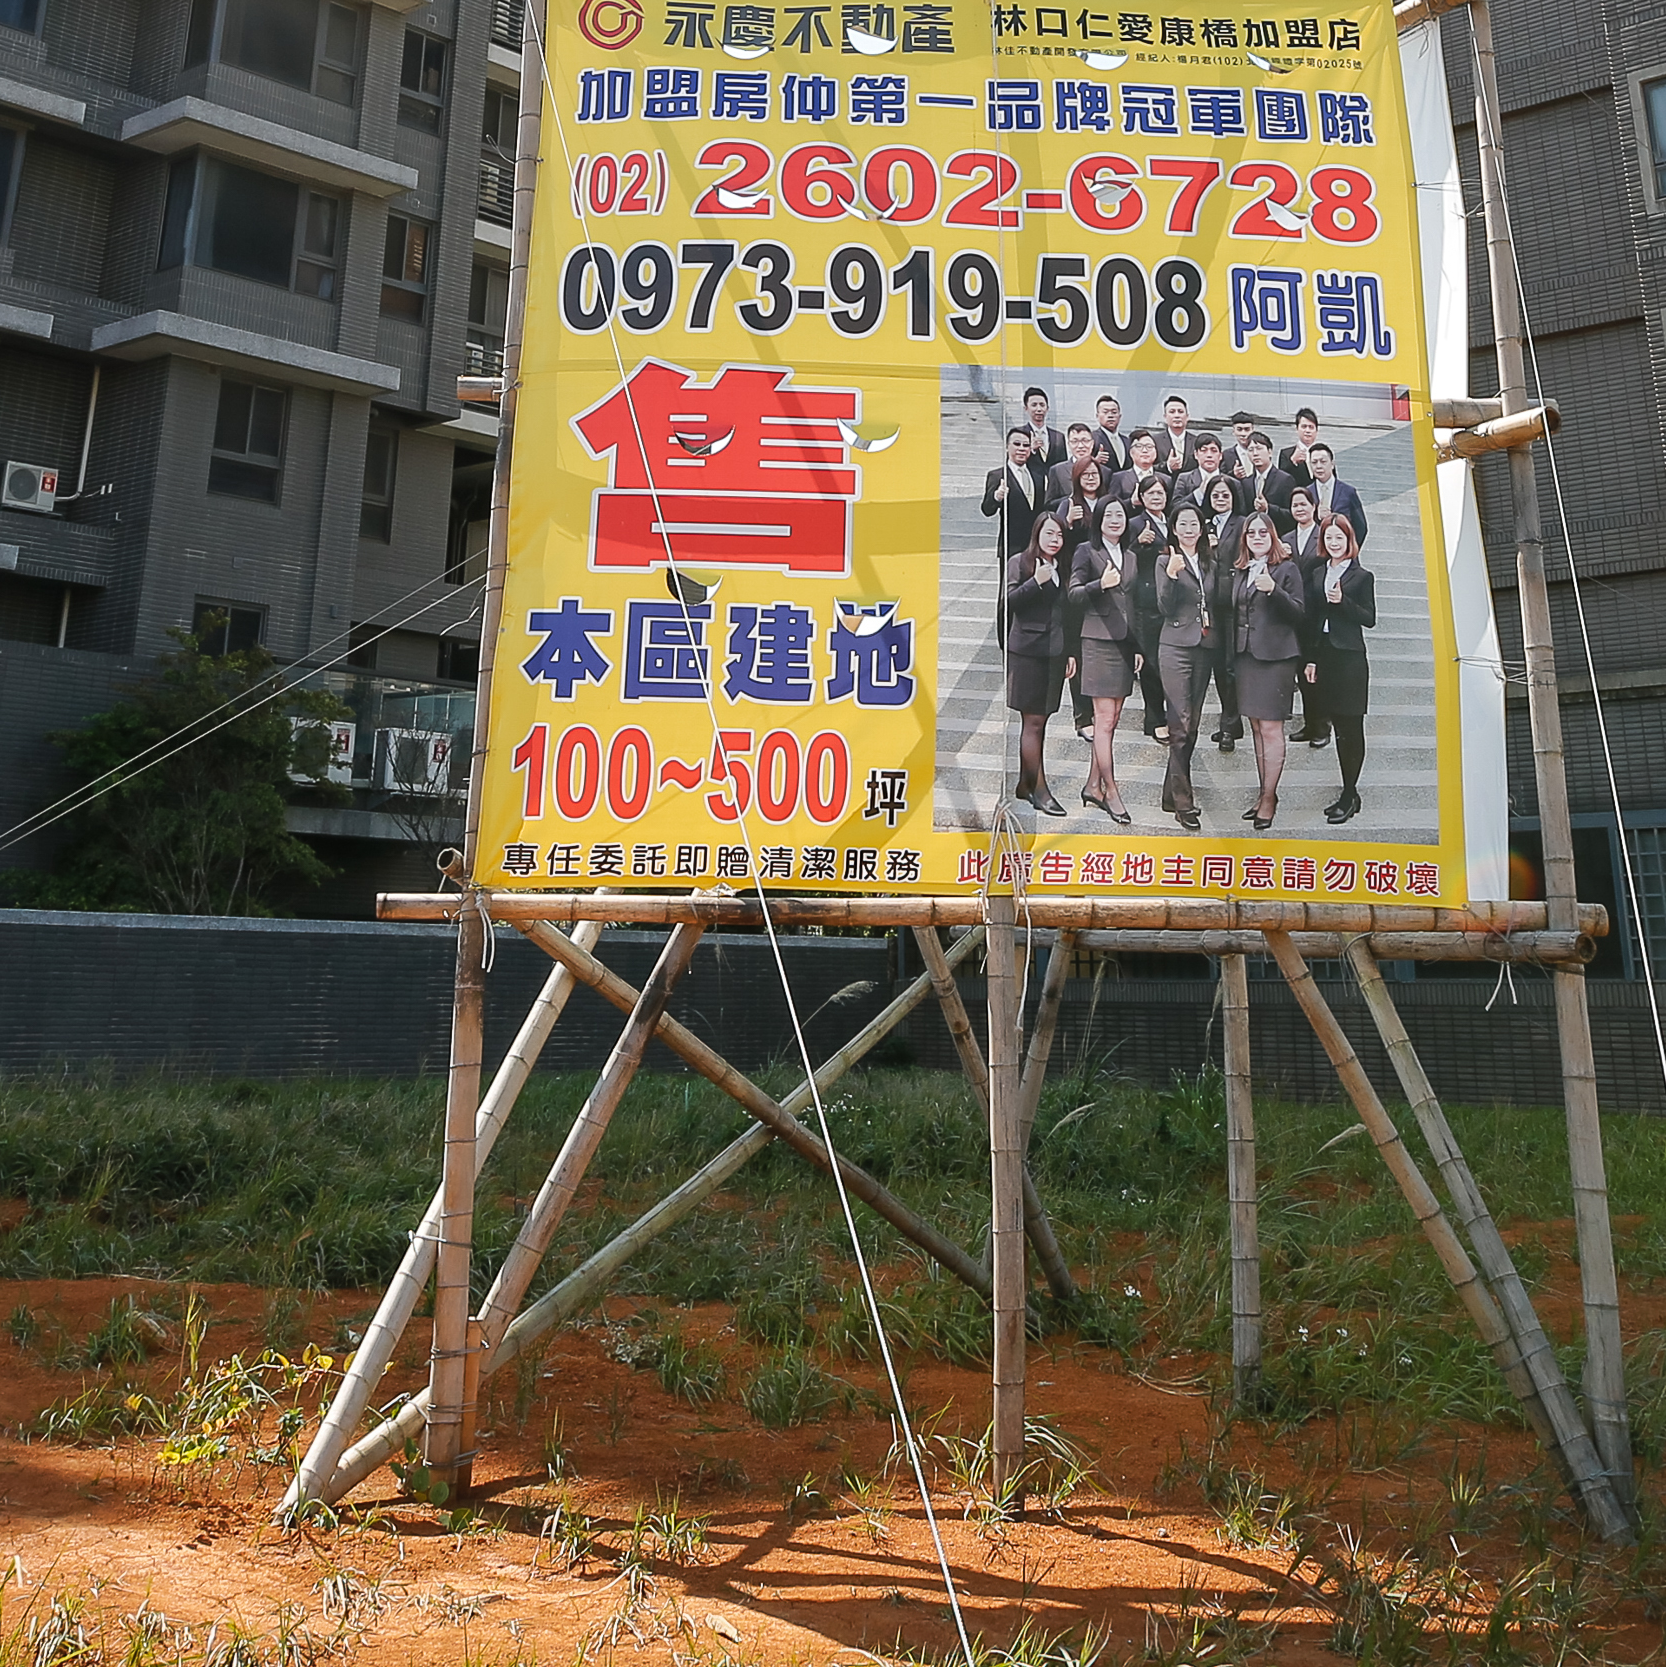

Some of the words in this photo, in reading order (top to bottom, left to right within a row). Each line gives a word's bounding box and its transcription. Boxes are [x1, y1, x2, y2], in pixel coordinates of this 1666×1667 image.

[664, 1, 955, 54] 永慶不動產
[992, 3, 1361, 52] 林口仁愛康橋加盟店
[578, 68, 1374, 145] 加盟房仲第一品牌冠軍團隊
[575, 152, 665, 216] (02)
[694, 141, 1379, 243] 2602-6728
[563, 243, 1206, 348] 0973-919-508
[1232, 267, 1392, 356] 阿凱
[576, 362, 856, 572] 售
[523, 600, 915, 704] 本區建地
[513, 725, 848, 822] 100~500
[864, 771, 908, 825] 坪
[502, 843, 921, 882] 專任委託即贈清潔服務
[957, 849, 1440, 896] 此廣告經地主同意請勿破壞
